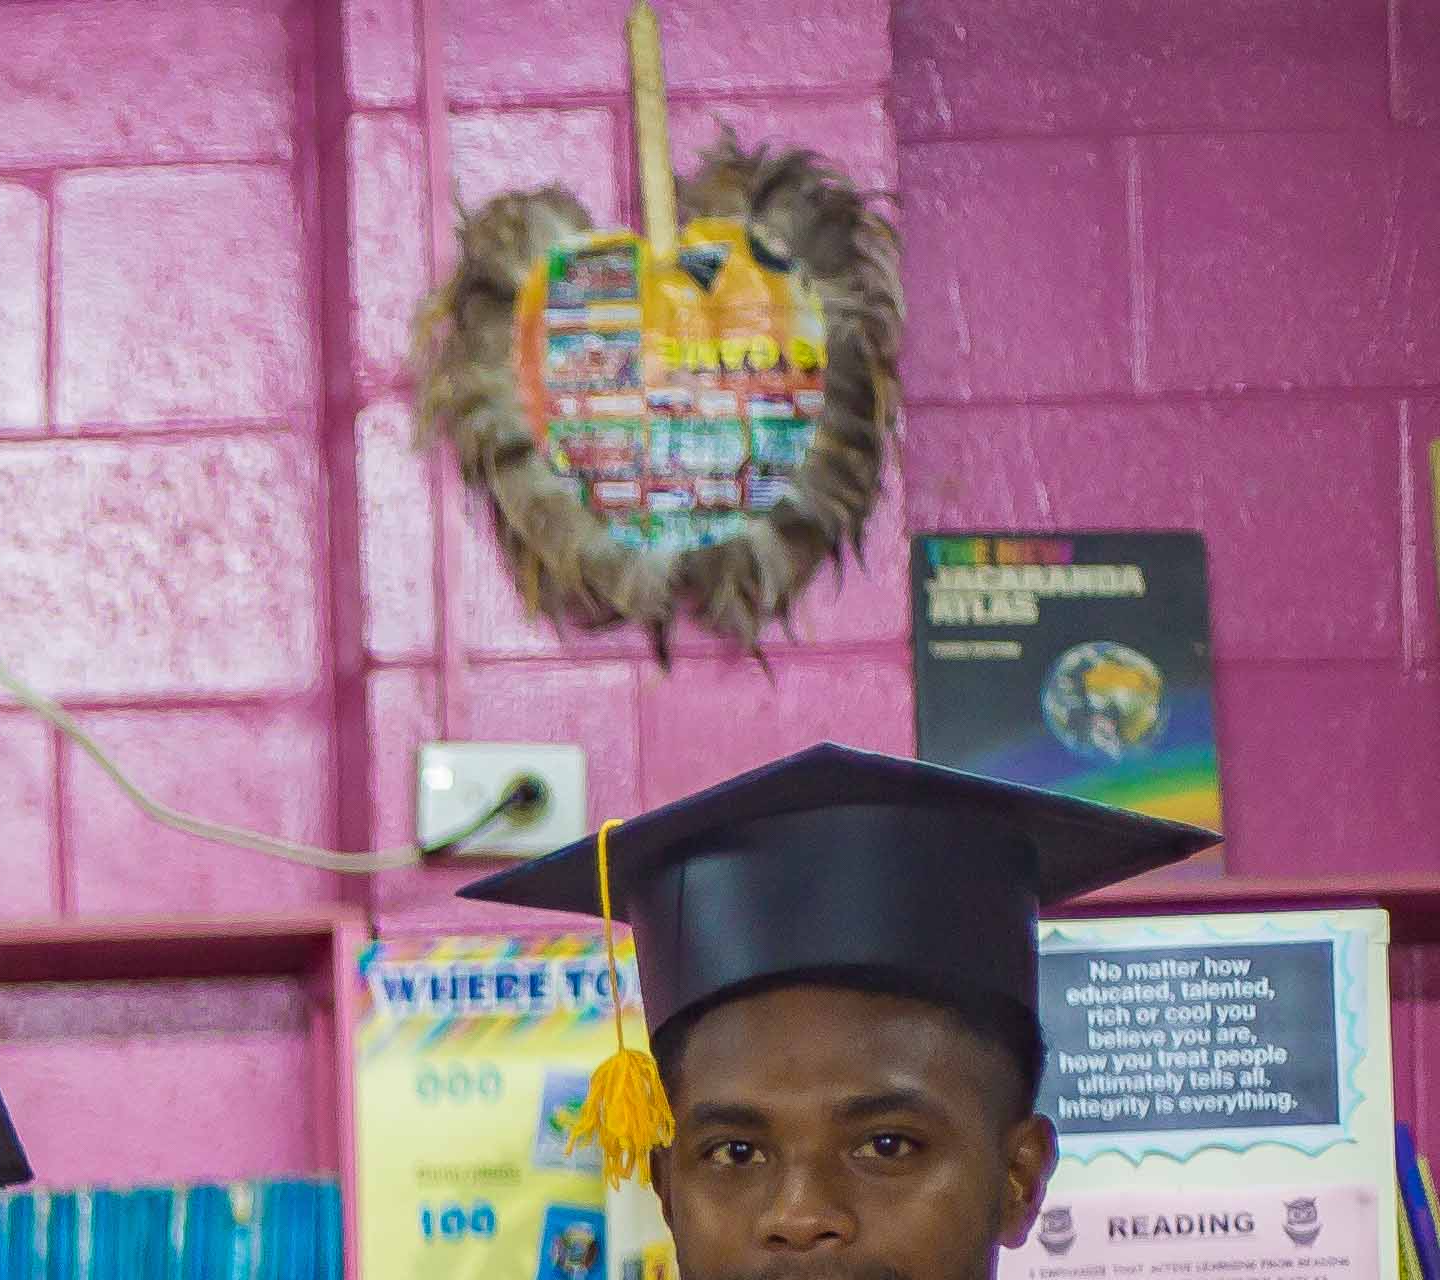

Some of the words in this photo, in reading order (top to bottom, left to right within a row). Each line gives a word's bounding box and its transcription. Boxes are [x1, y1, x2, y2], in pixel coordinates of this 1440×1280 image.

[1088, 959, 1123, 982] No
[1127, 958, 1202, 979] matter
[1205, 956, 1253, 978] how
[383, 969, 547, 1002] WHERE
[1066, 980, 1177, 1005] educated,
[1181, 976, 1276, 1001] talented,
[1087, 1004, 1130, 1027] rich
[1135, 1007, 1161, 1025] or
[1164, 1002, 1212, 1024] cool
[1215, 1005, 1257, 1026] you
[1088, 1027, 1167, 1050] believe
[1170, 1028, 1212, 1048] you
[1215, 1026, 1258, 1046] are,
[1058, 1051, 1109, 1073] how
[1113, 1052, 1154, 1075] you
[1158, 1048, 1209, 1070] treat
[1213, 1044, 1289, 1069] people
[1077, 1071, 1185, 1095] ultimately
[1189, 1068, 1236, 1090] tells
[1057, 1095, 1151, 1121] Integrity
[1155, 1093, 1176, 1114] is
[420, 1203, 497, 1239] 100
[1107, 1211, 1257, 1240] READING
